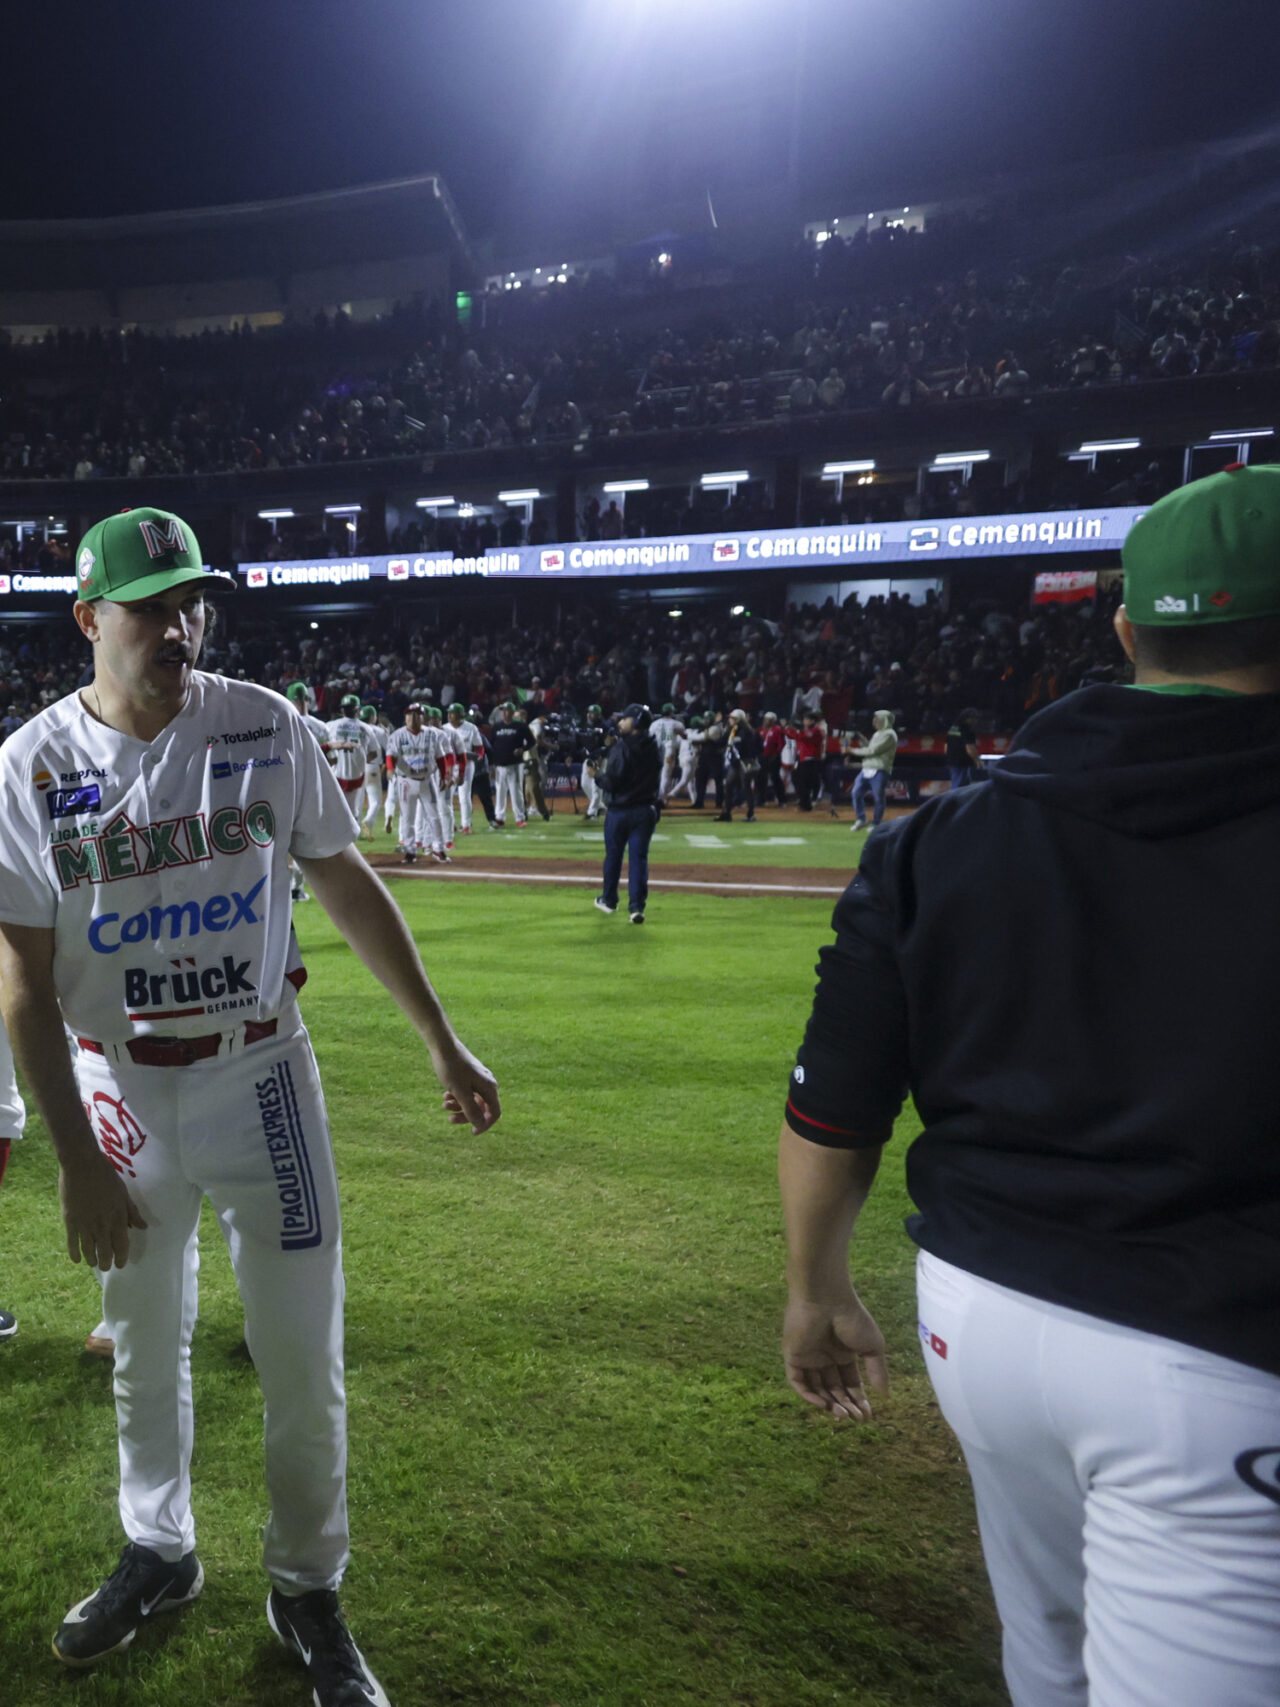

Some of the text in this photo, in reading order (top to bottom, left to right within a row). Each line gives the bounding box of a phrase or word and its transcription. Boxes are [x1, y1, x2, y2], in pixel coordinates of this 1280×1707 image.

[139, 518, 189, 560] M
[746, 530, 882, 558] Cemenquin
[947, 516, 1102, 547] Cemenquin
[414, 553, 520, 577] Cemenquin
[570, 541, 689, 568] Cemenquin
[271, 562, 370, 585] Cemenquin
[50, 823, 99, 844] LIGA DE
[51, 801, 275, 891] MÉXICO
[125, 956, 257, 1008] Brück
[207, 996, 260, 1014] GERMANY
[255, 1080, 306, 1229] PAQUETEXPRESS
